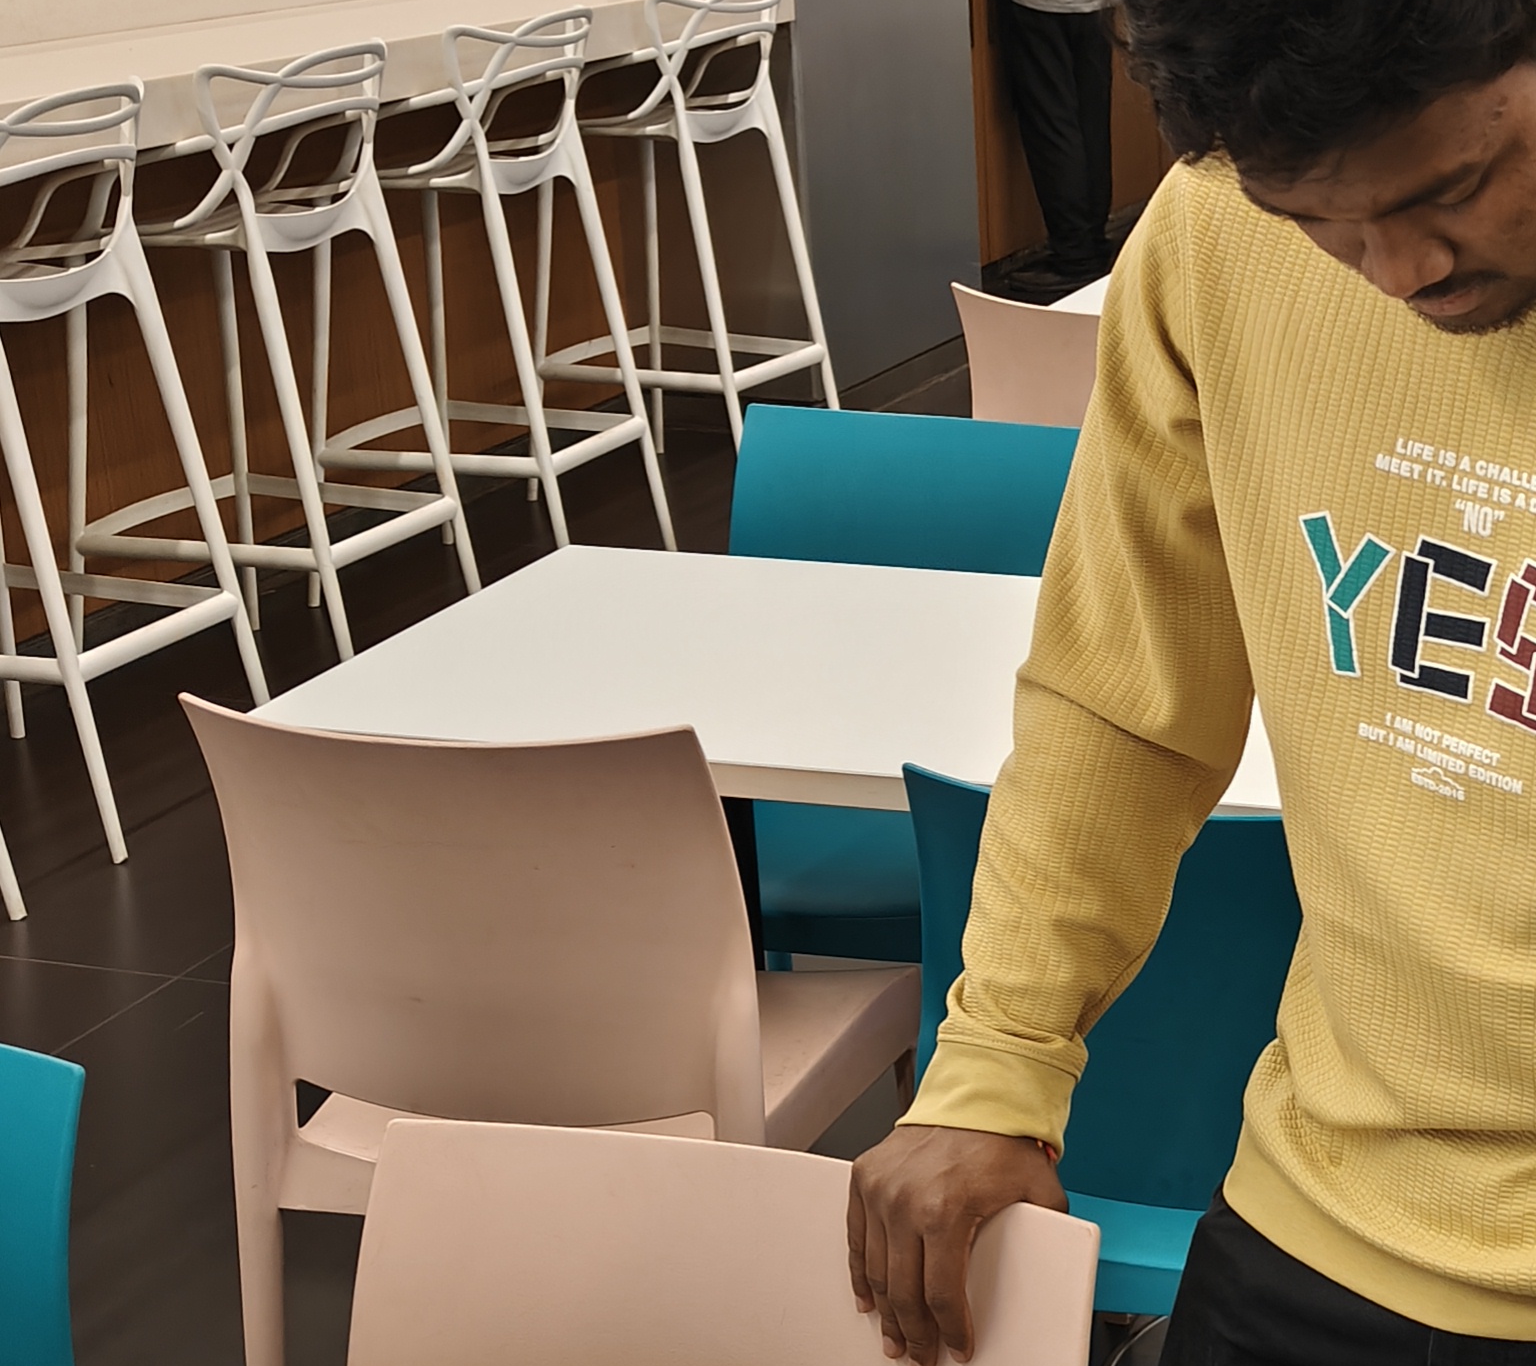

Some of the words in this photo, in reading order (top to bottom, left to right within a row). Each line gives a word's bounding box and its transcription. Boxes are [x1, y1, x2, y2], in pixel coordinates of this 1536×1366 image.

[1375, 453, 1423, 480] MEET
[1426, 468, 1447, 487] IT.
[1451, 475, 1489, 498] LIFE
[1492, 486, 1511, 504] IS
[1514, 493, 1526, 509] A
[1395, 438, 1434, 461] LIFE
[1438, 449, 1457, 467] IS
[1459, 455, 1471, 472] A
[1358, 722, 1386, 742] BUT
[1388, 732, 1394, 746] I
[1396, 736, 1415, 754] AM
[1416, 744, 1466, 774] LIMITED
[1468, 764, 1523, 795] EDITION
[1385, 712, 1391, 726] I
[1394, 716, 1413, 734] AM
[1415, 723, 1441, 744] NOT
[1441, 734, 1501, 766] PERFECT
